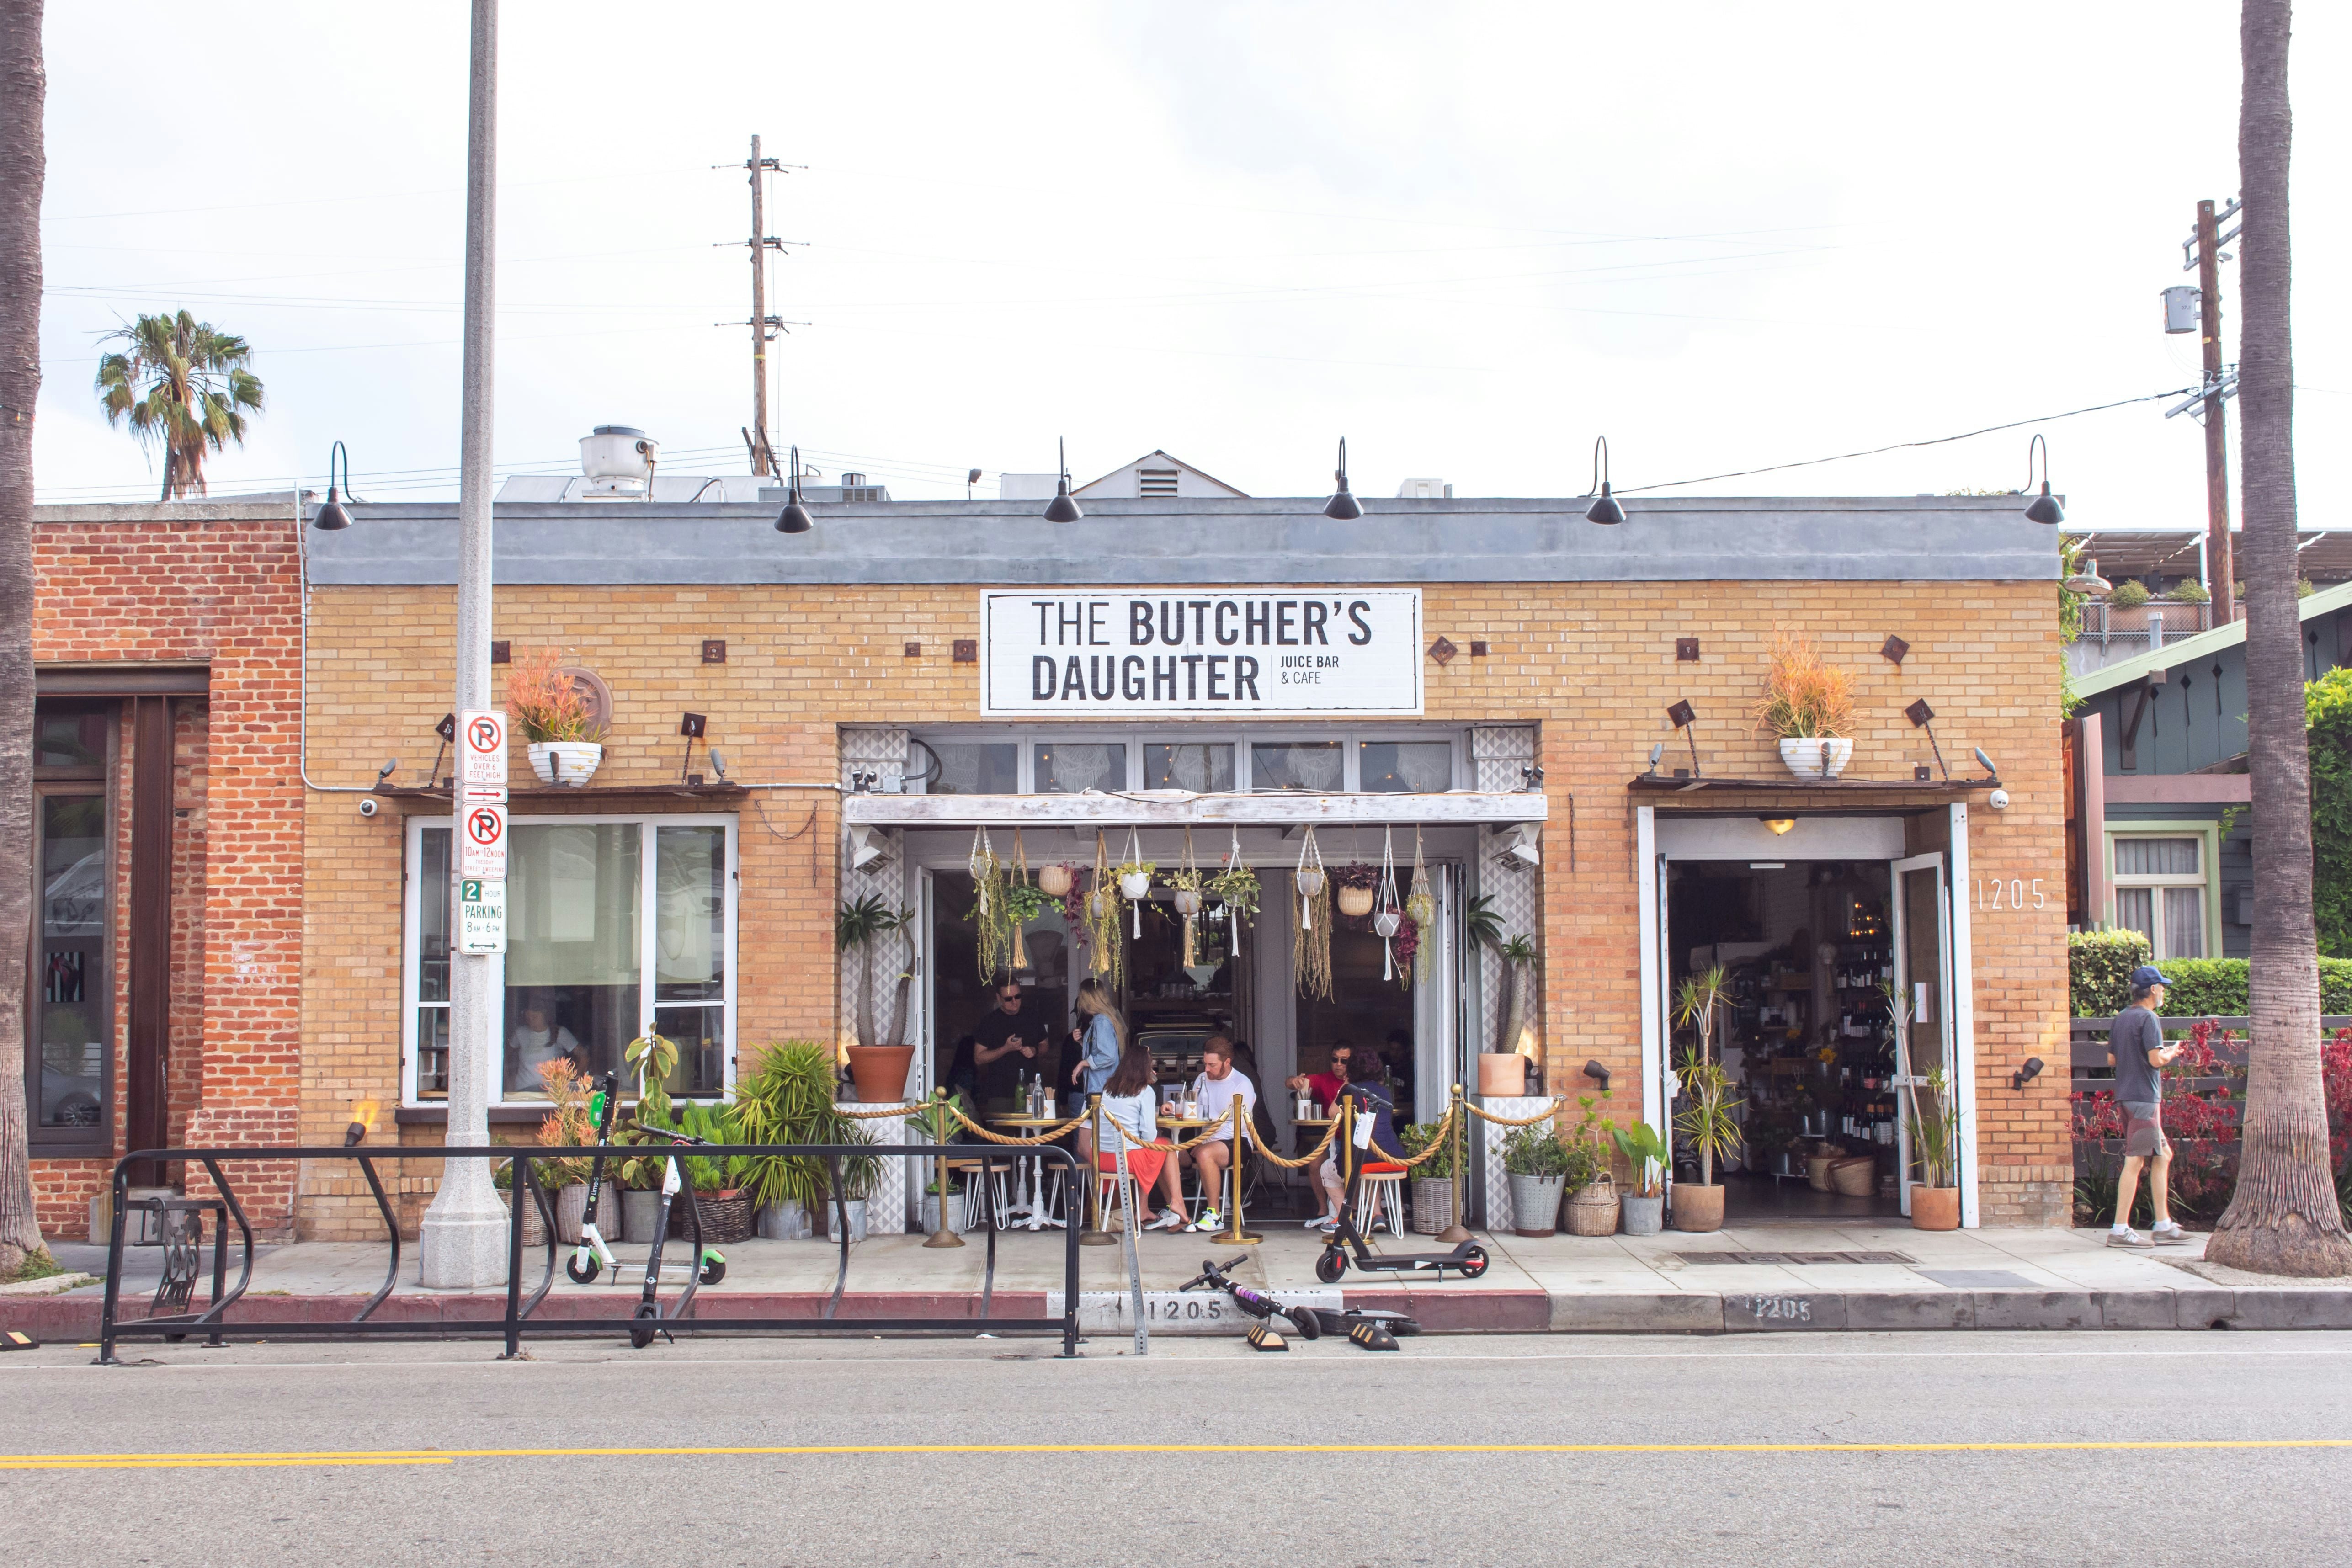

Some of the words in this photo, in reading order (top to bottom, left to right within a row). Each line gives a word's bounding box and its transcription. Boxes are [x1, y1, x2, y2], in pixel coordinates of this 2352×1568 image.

[1032, 602, 1110, 645] THE
[1130, 601, 1372, 646] BUTCHER'S
[1281, 656, 1312, 668] JUICE
[1317, 656, 1339, 668] BAR
[1032, 655, 1260, 701] DAUGHTER
[1281, 671, 1289, 684] &
[1293, 672, 1321, 684] CAFE
[465, 846, 479, 856] 10AM
[467, 882, 477, 899] 2
[1978, 879, 2044, 909] 1205
[466, 905, 502, 919] PARKING
[467, 921, 472, 932] 8
[486, 922, 491, 932] 6
[1149, 1301, 1221, 1319] 1205
